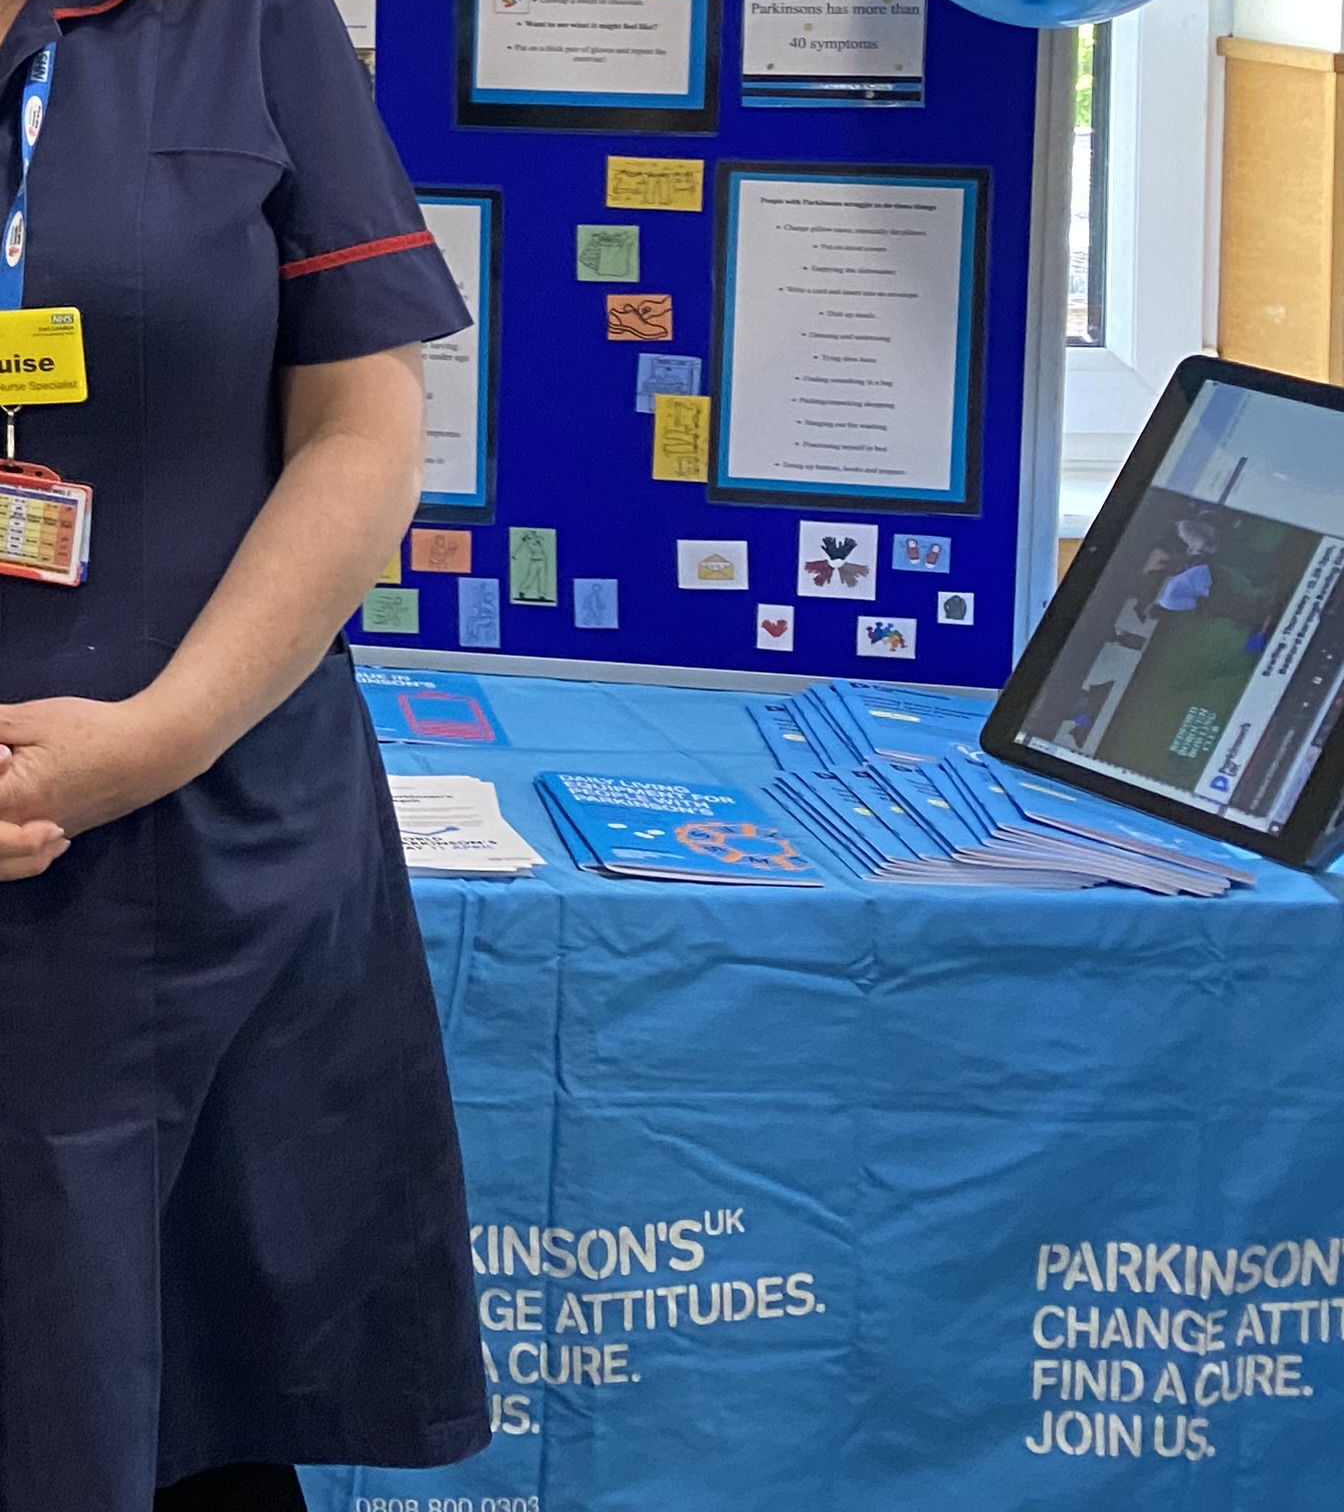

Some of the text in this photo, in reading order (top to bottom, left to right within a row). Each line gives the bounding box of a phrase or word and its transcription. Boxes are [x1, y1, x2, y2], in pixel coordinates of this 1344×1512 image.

[752, 3, 920, 15] Parkinsons has more than
[789, 37, 878, 52] 40 symptoms
[29, 379, 78, 391] Specialist
[558, 774, 690, 794] DAILY LIVING
[653, 796, 711, 808] WITH
[691, 793, 736, 804] FOR
[555, 1272, 826, 1335] ATTITUDES.
[1033, 1305, 1228, 1356] CHANGE
[508, 1342, 641, 1385] CURE.
[1033, 1354, 1314, 1407] FIND A CURE.
[1025, 1410, 1215, 1461] JOIN US.
